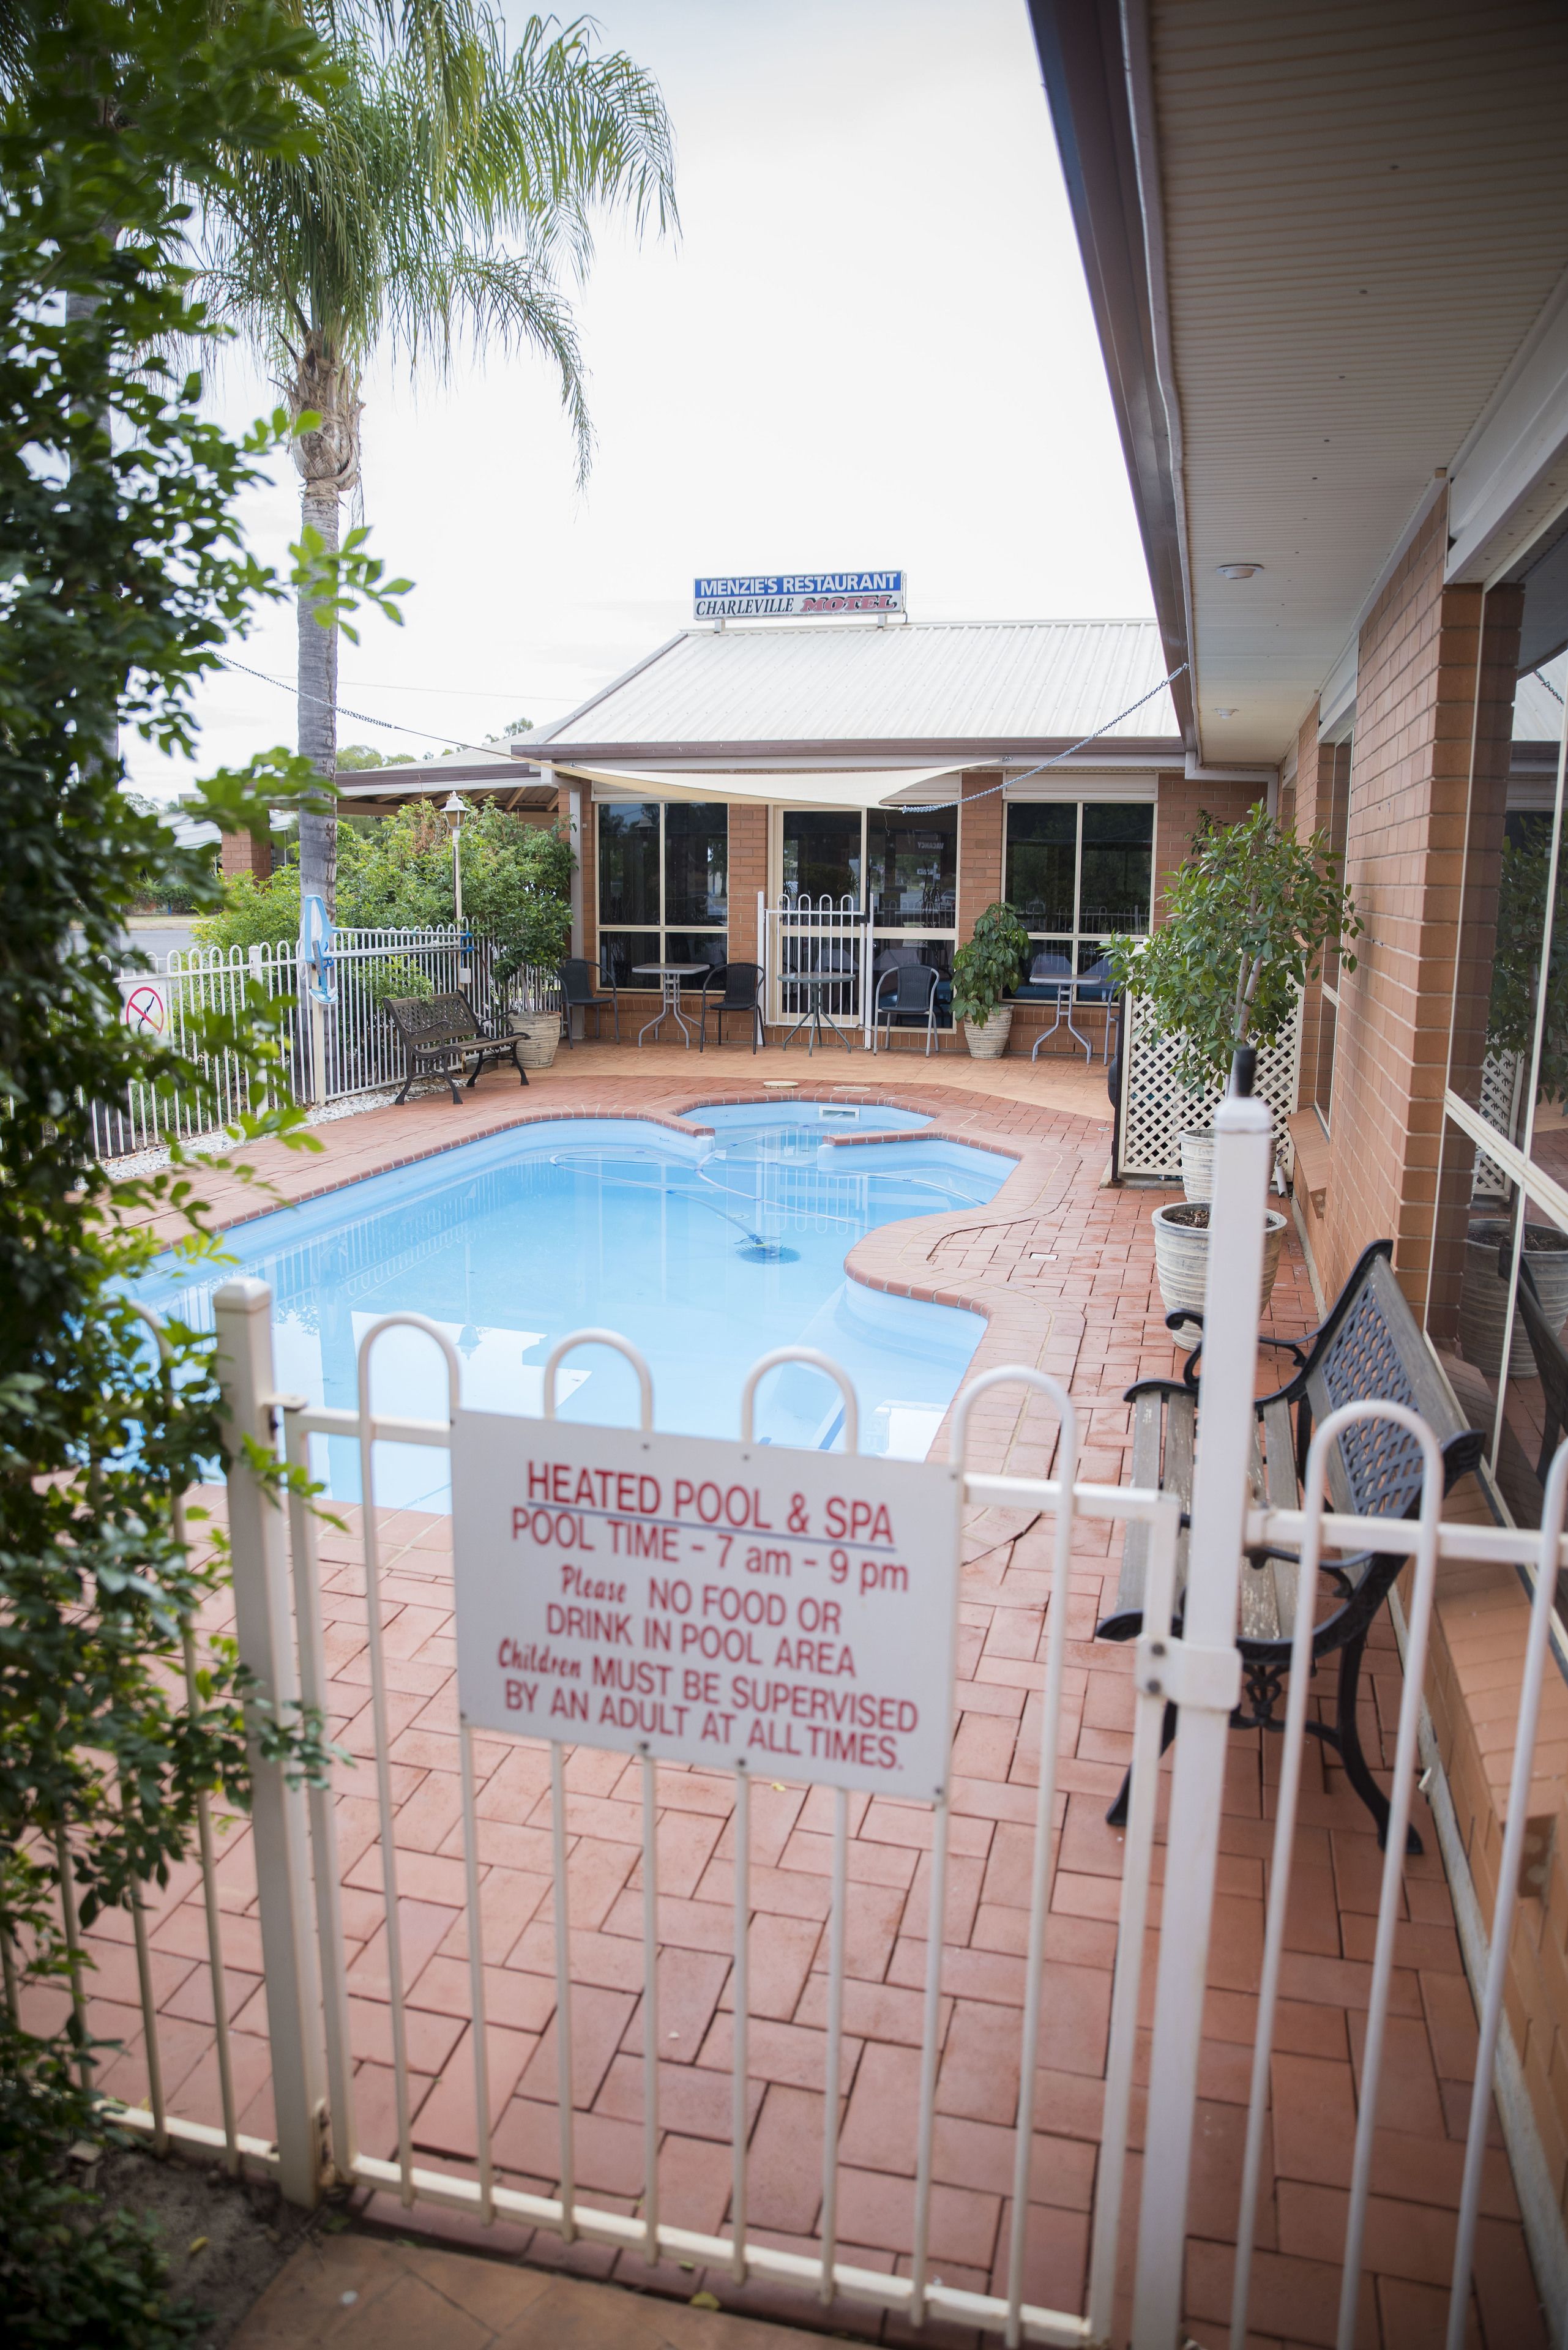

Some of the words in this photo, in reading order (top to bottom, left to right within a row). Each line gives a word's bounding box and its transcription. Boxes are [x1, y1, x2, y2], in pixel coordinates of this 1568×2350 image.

[696, 597, 794, 616] CHARLEVILLE
[800, 594, 898, 612] MOTEL
[701, 577, 777, 596] MENZIE'S
[783, 573, 897, 592] RESTAURANT
[527, 1460, 662, 1515] HEATED
[673, 1478, 772, 1531] POOL
[786, 1492, 810, 1535] &
[824, 1495, 894, 1544] SPA
[512, 1506, 595, 1551] POOL
[606, 1519, 679, 1563] TIME
[717, 1533, 734, 1568] 7
[745, 1546, 791, 1576] am
[829, 1548, 849, 1584] 9
[859, 1561, 909, 1596] pm
[561, 1563, 626, 1604] Please
[649, 1577, 692, 1615] NO
[702, 1584, 786, 1627] FOOD
[797, 1597, 842, 1635] OR
[547, 1602, 632, 1646] DRINK
[644, 1618, 671, 1652] IN
[681, 1622, 761, 1665] POOL
[774, 1636, 856, 1678] AREA
[497, 1638, 581, 1679] Children
[592, 1655, 673, 1696] MUST
[683, 1668, 720, 1705] BE
[731, 1674, 919, 1733] SUPERVISED
[505, 1678, 539, 1712] BY
[550, 1687, 589, 1721] AN
[599, 1695, 689, 1737] ADULT
[700, 1711, 736, 1744] AT
[747, 1718, 802, 1756] ALL
[807, 1725, 905, 1771] TIMES.
